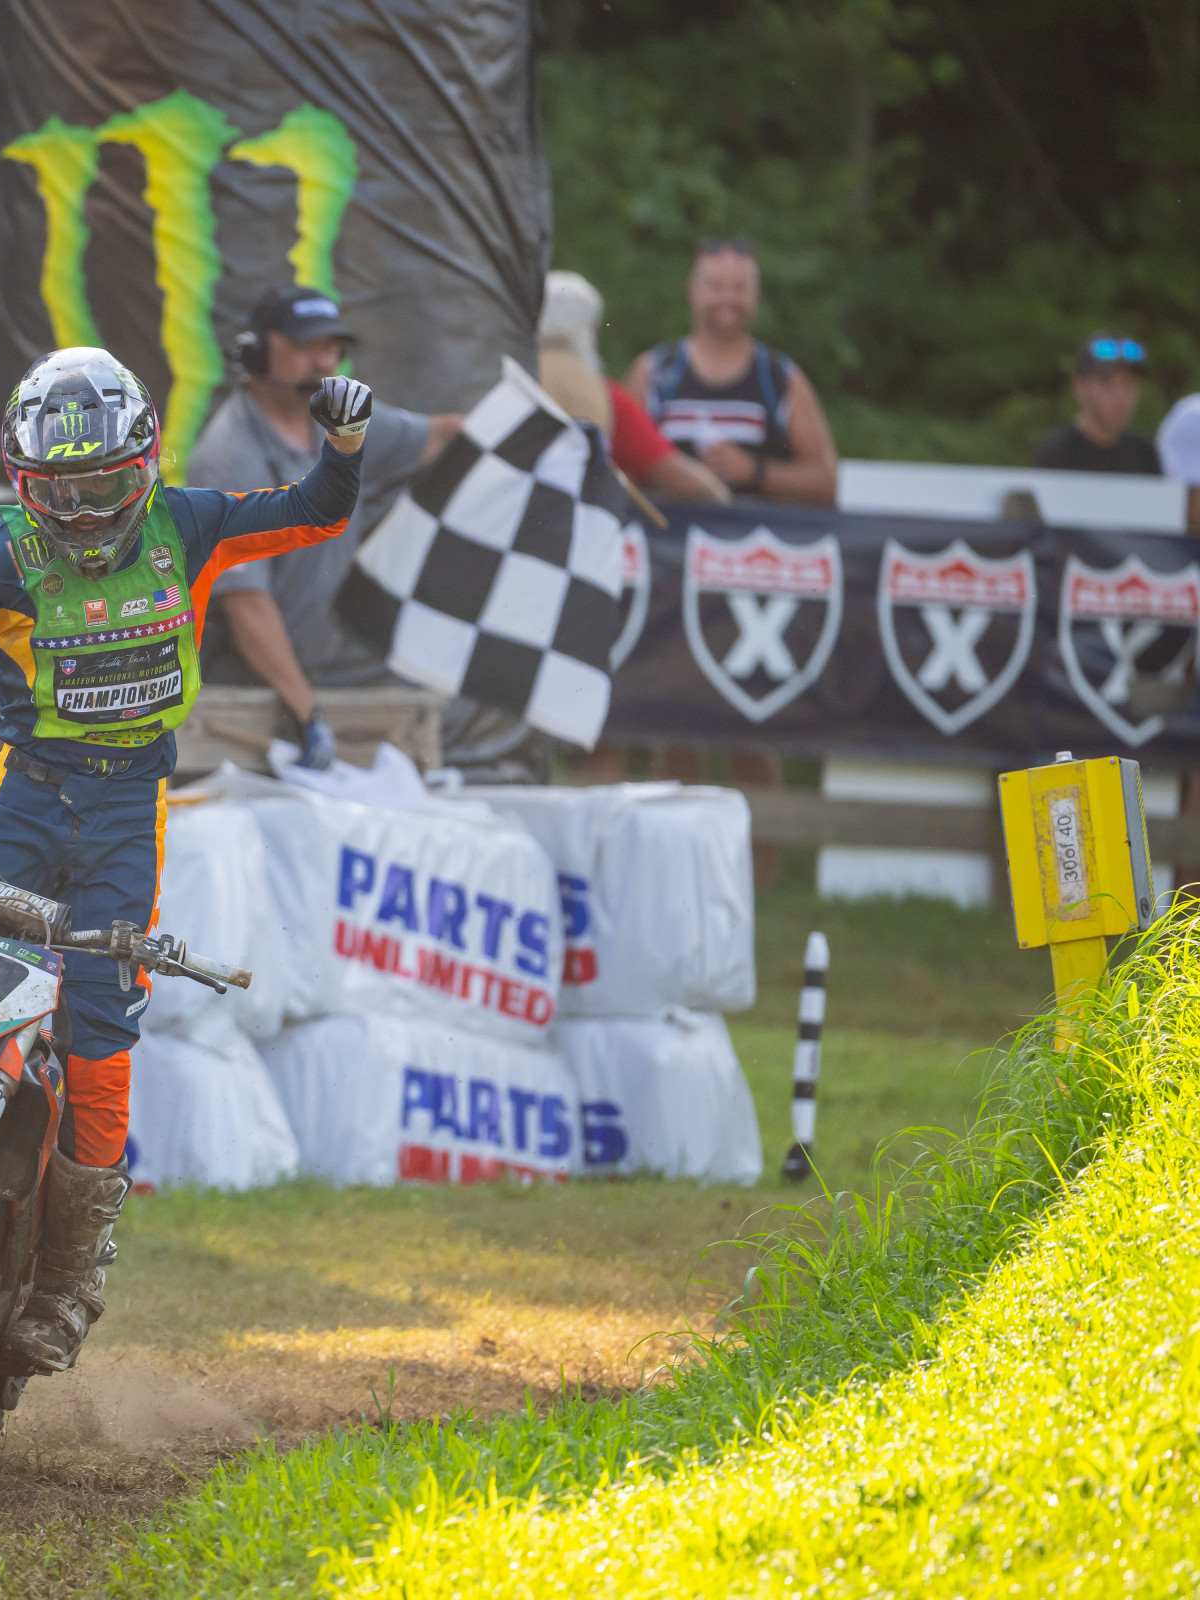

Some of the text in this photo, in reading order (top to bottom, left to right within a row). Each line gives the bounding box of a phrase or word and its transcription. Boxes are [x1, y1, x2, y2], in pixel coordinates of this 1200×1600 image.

[46, 441, 103, 460] FLY
[723, 591, 799, 680] X
[916, 602, 992, 694] X
[59, 659, 177, 686] AMATEUR NATIONAL MOTOCROSS
[62, 674, 180, 710] CHAMPIONSHIP
[1057, 815, 1072, 837] 40
[337, 844, 552, 980] PARTS
[333, 918, 555, 1029] UNLIMITED
[401, 1065, 574, 1160] PARTS
[2, 1188, 16, 1198] Air
